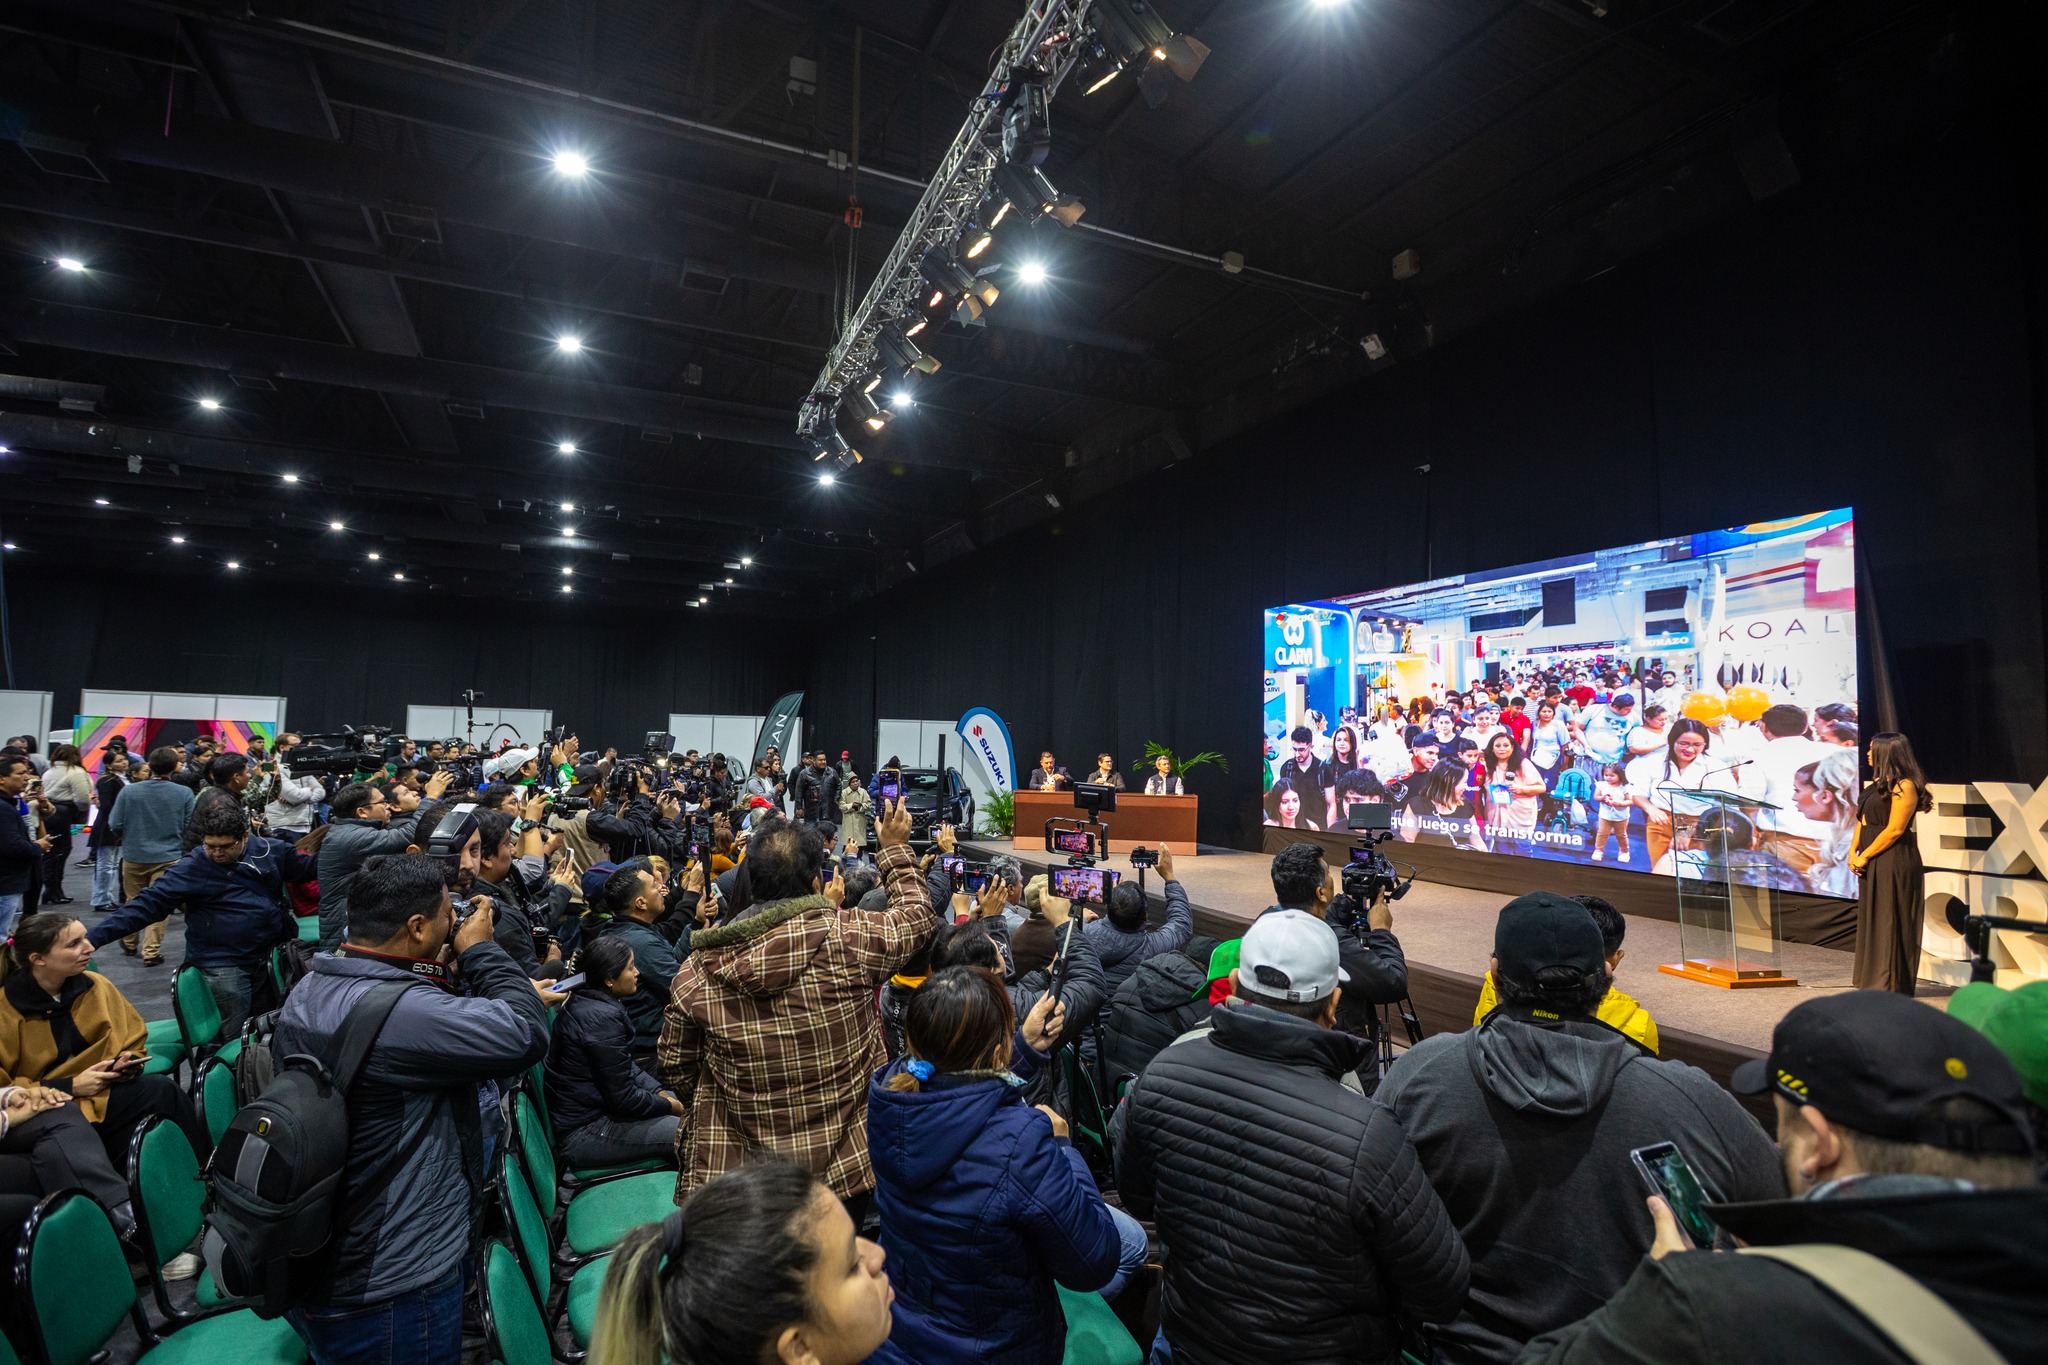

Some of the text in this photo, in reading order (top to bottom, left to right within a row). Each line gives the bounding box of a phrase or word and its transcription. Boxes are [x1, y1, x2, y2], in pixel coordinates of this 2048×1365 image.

[1718, 615, 1841, 642] KOAL
[1275, 647, 1313, 666] CLARVI
[769, 713, 788, 748] AN
[980, 737, 1006, 786] SUZUKI
[1391, 816, 1583, 846] que luego se transforma
[412, 962, 443, 976] EOS 7D
[1532, 1009, 1559, 1020] Nikon
